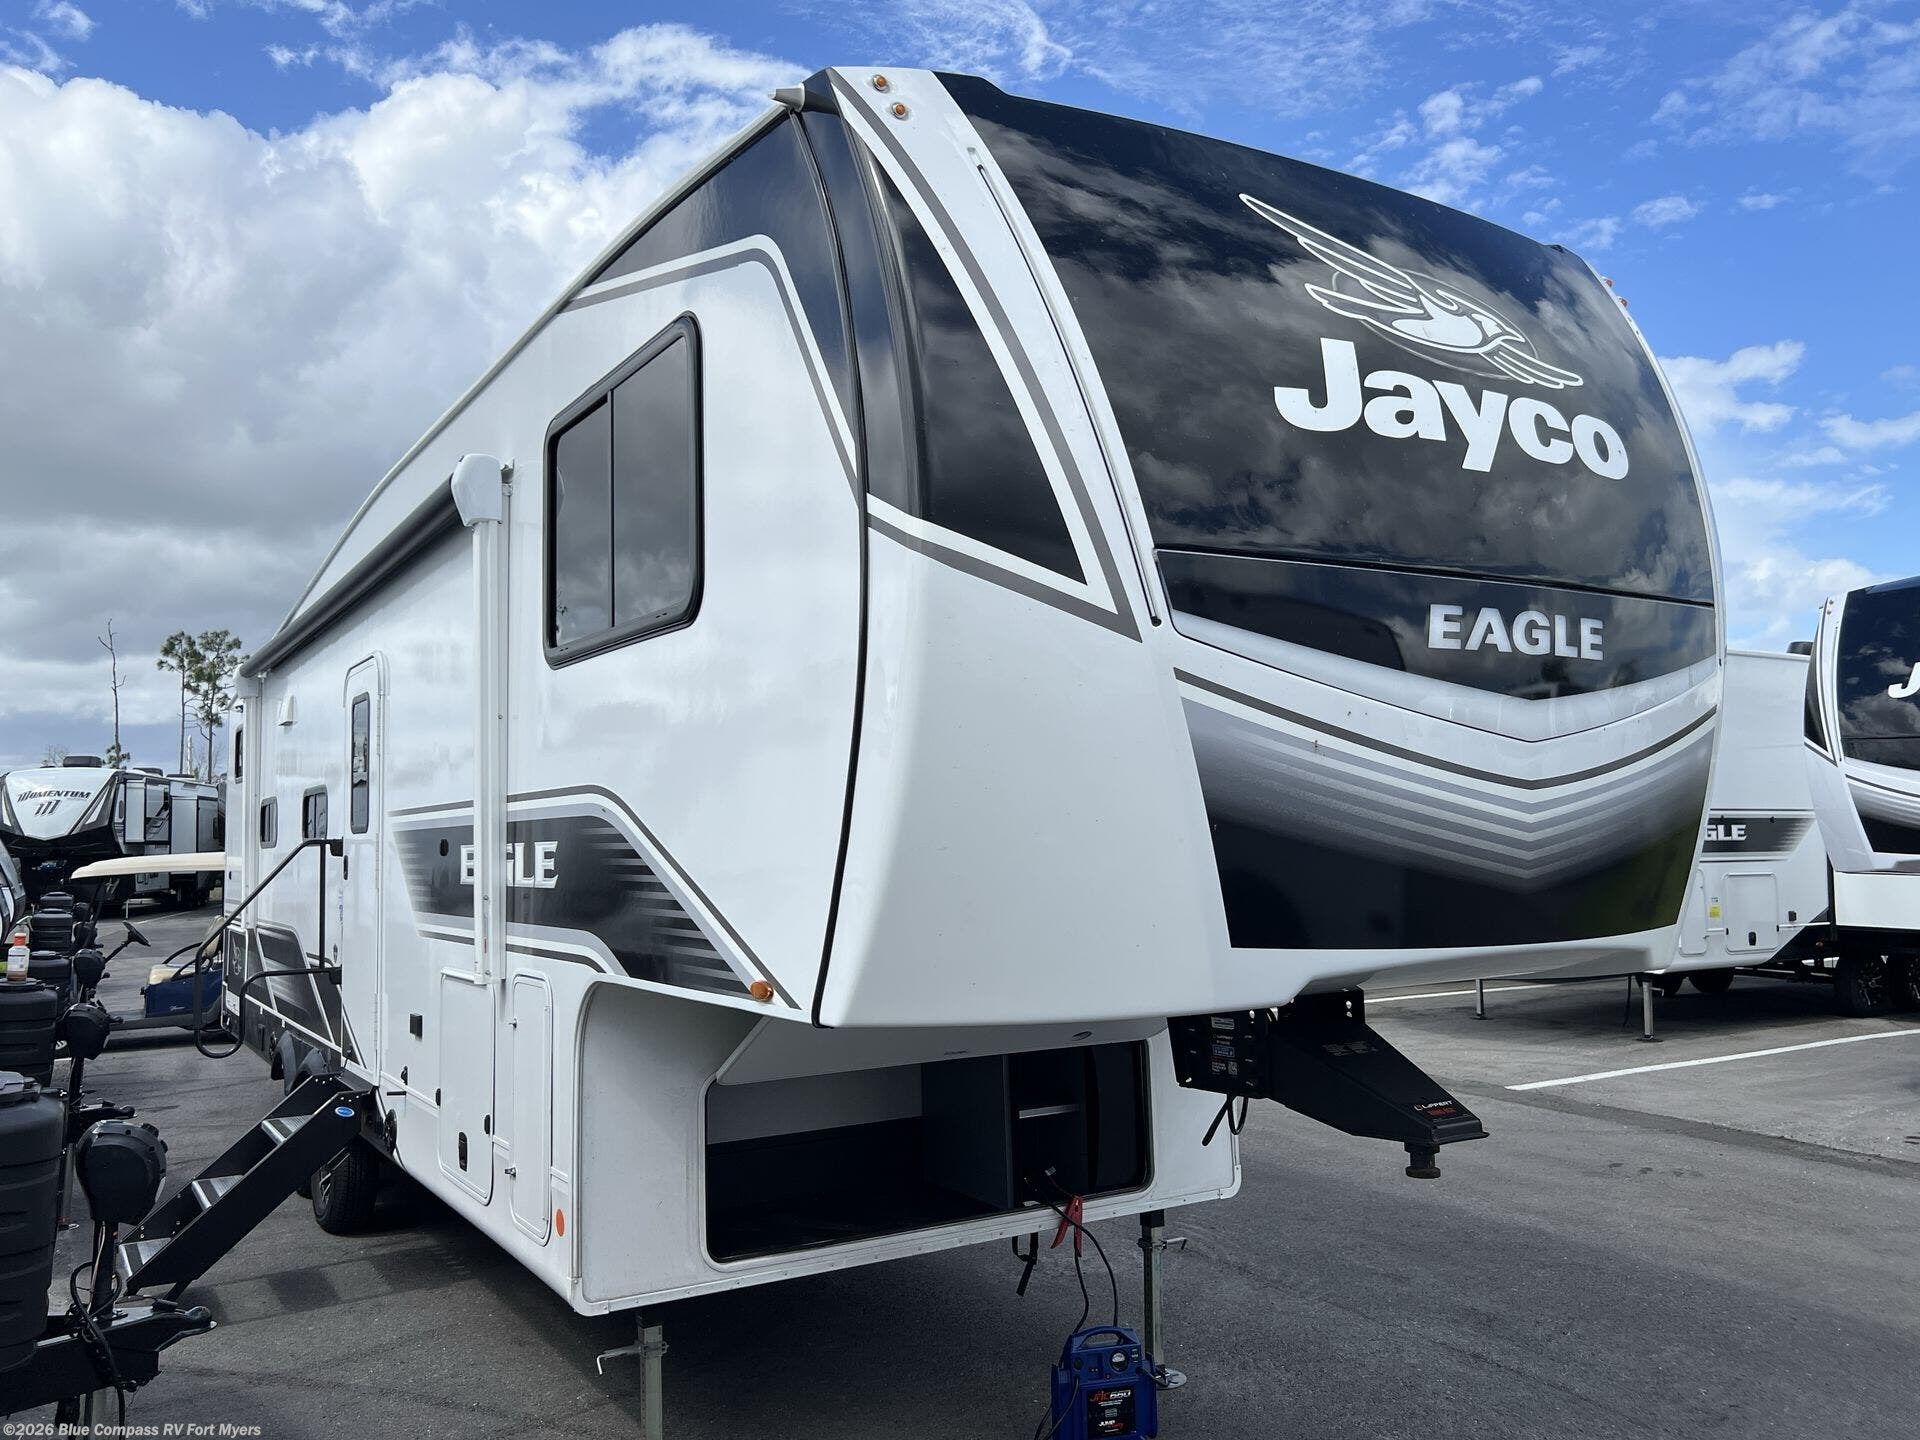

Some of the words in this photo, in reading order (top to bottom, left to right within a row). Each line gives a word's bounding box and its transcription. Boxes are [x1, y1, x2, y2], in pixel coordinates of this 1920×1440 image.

[1273, 336, 1630, 481] Jayco
[1427, 603, 1605, 661] EAGLE
[17, 791, 92, 803] MOMENTUM
[1704, 824, 1748, 841] GLE
[460, 841, 559, 889] ELE
